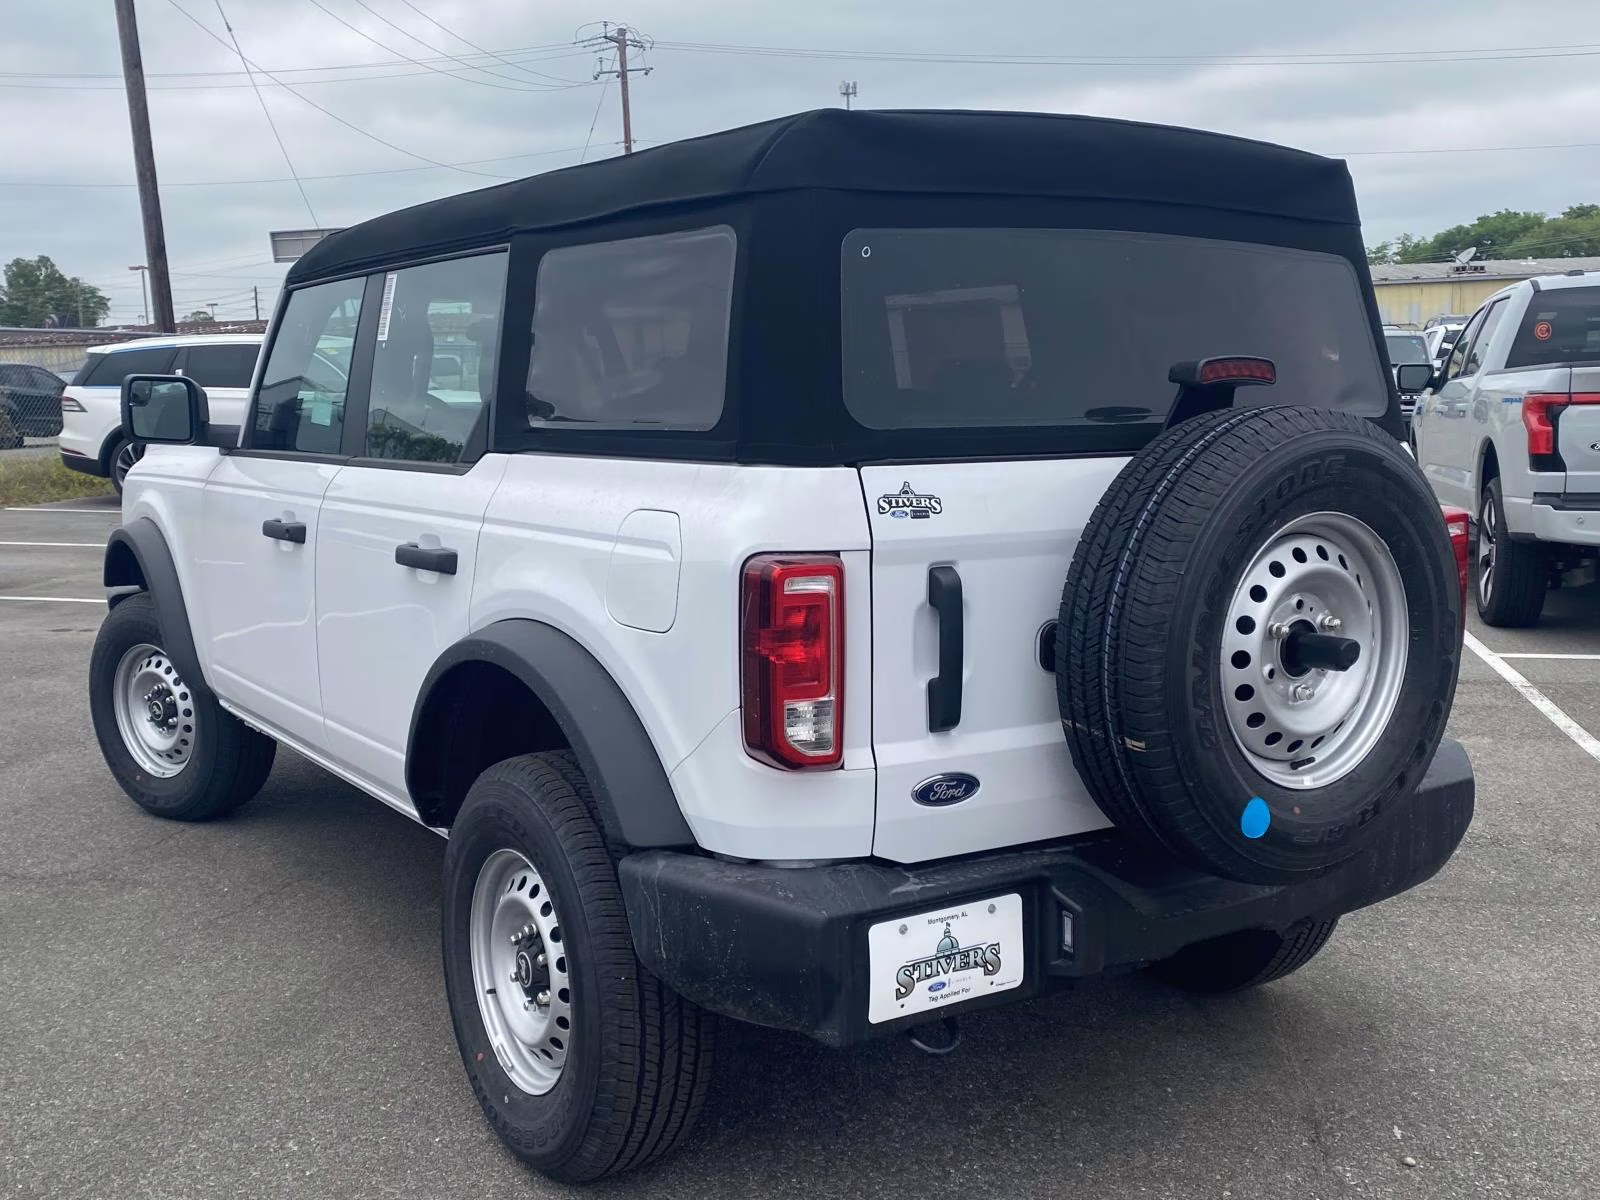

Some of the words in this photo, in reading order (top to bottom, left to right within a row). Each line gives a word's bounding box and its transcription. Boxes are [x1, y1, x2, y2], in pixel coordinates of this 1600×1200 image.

[877, 496, 942, 514] STIVERS
[929, 781, 966, 801] Ford
[895, 942, 1002, 1001] STIVERS
